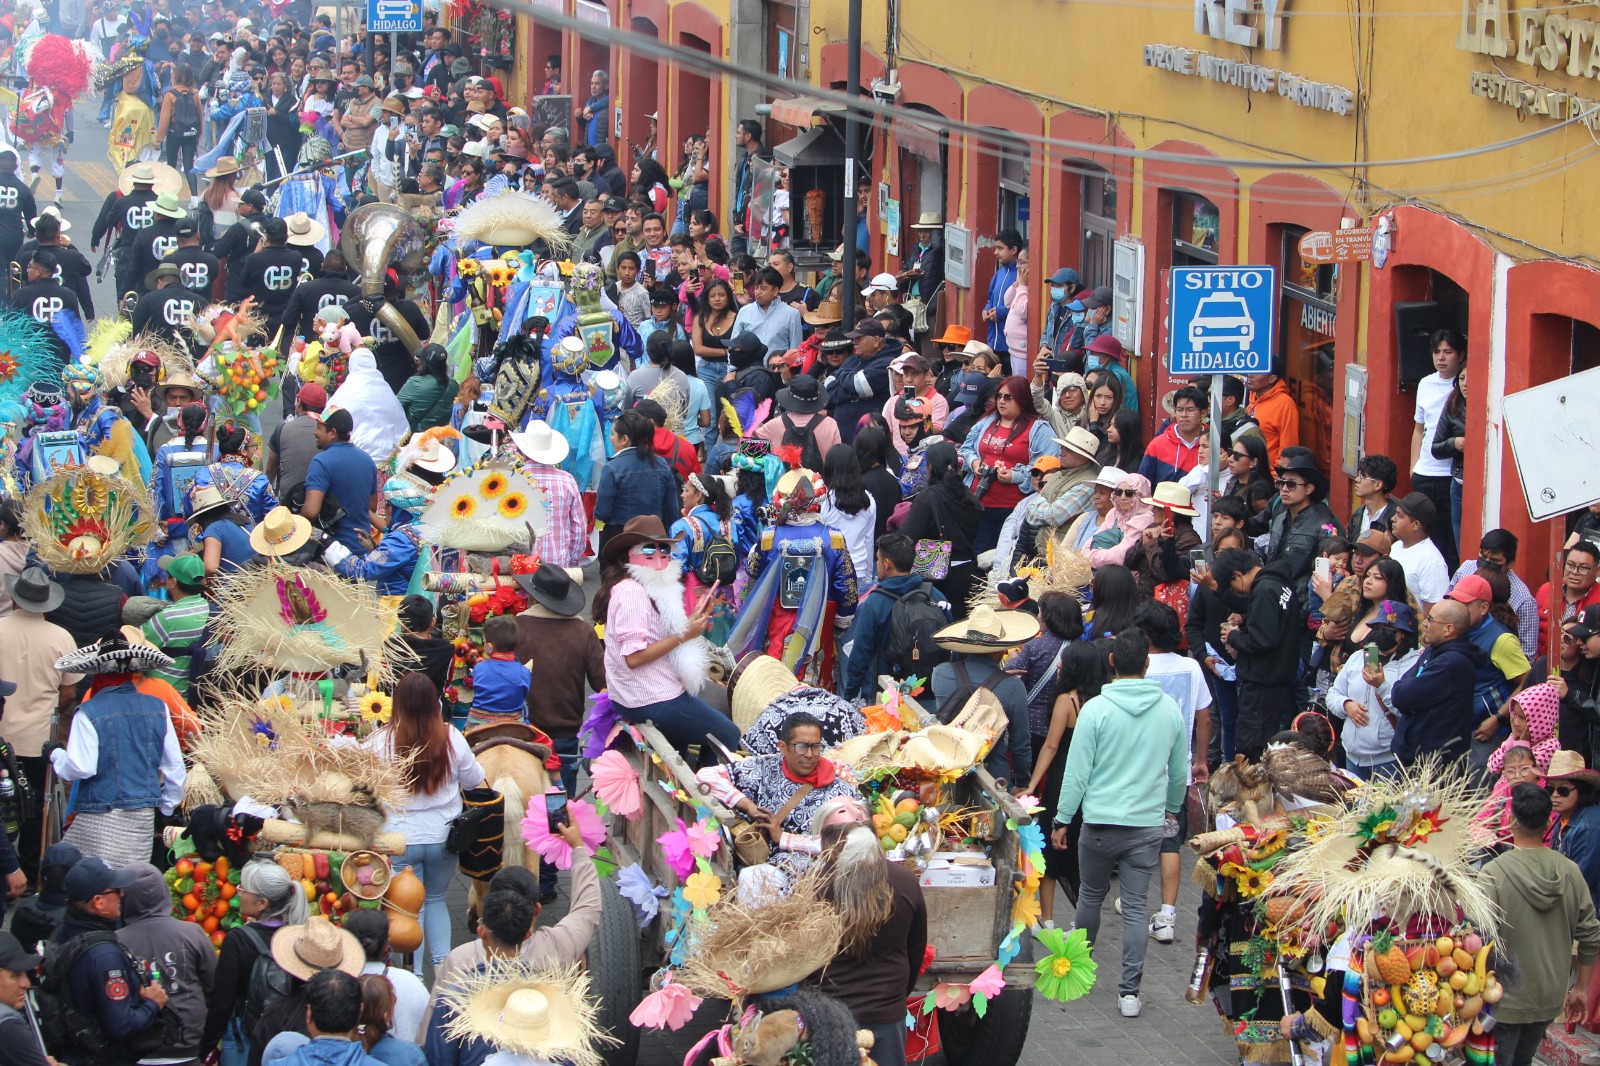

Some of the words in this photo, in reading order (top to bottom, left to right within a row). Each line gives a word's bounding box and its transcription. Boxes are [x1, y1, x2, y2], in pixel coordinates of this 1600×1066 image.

[373, 20, 417, 30] HIDALGO
[1143, 44, 1195, 75] POZOLE
[1196, 54, 1274, 93] ANTOJITOS
[1278, 72, 1354, 116] CARNITAS
[1184, 271, 1263, 290] SITIO
[1181, 351, 1259, 370] HIDALGO
[1168, 376, 1189, 386] Sopes
